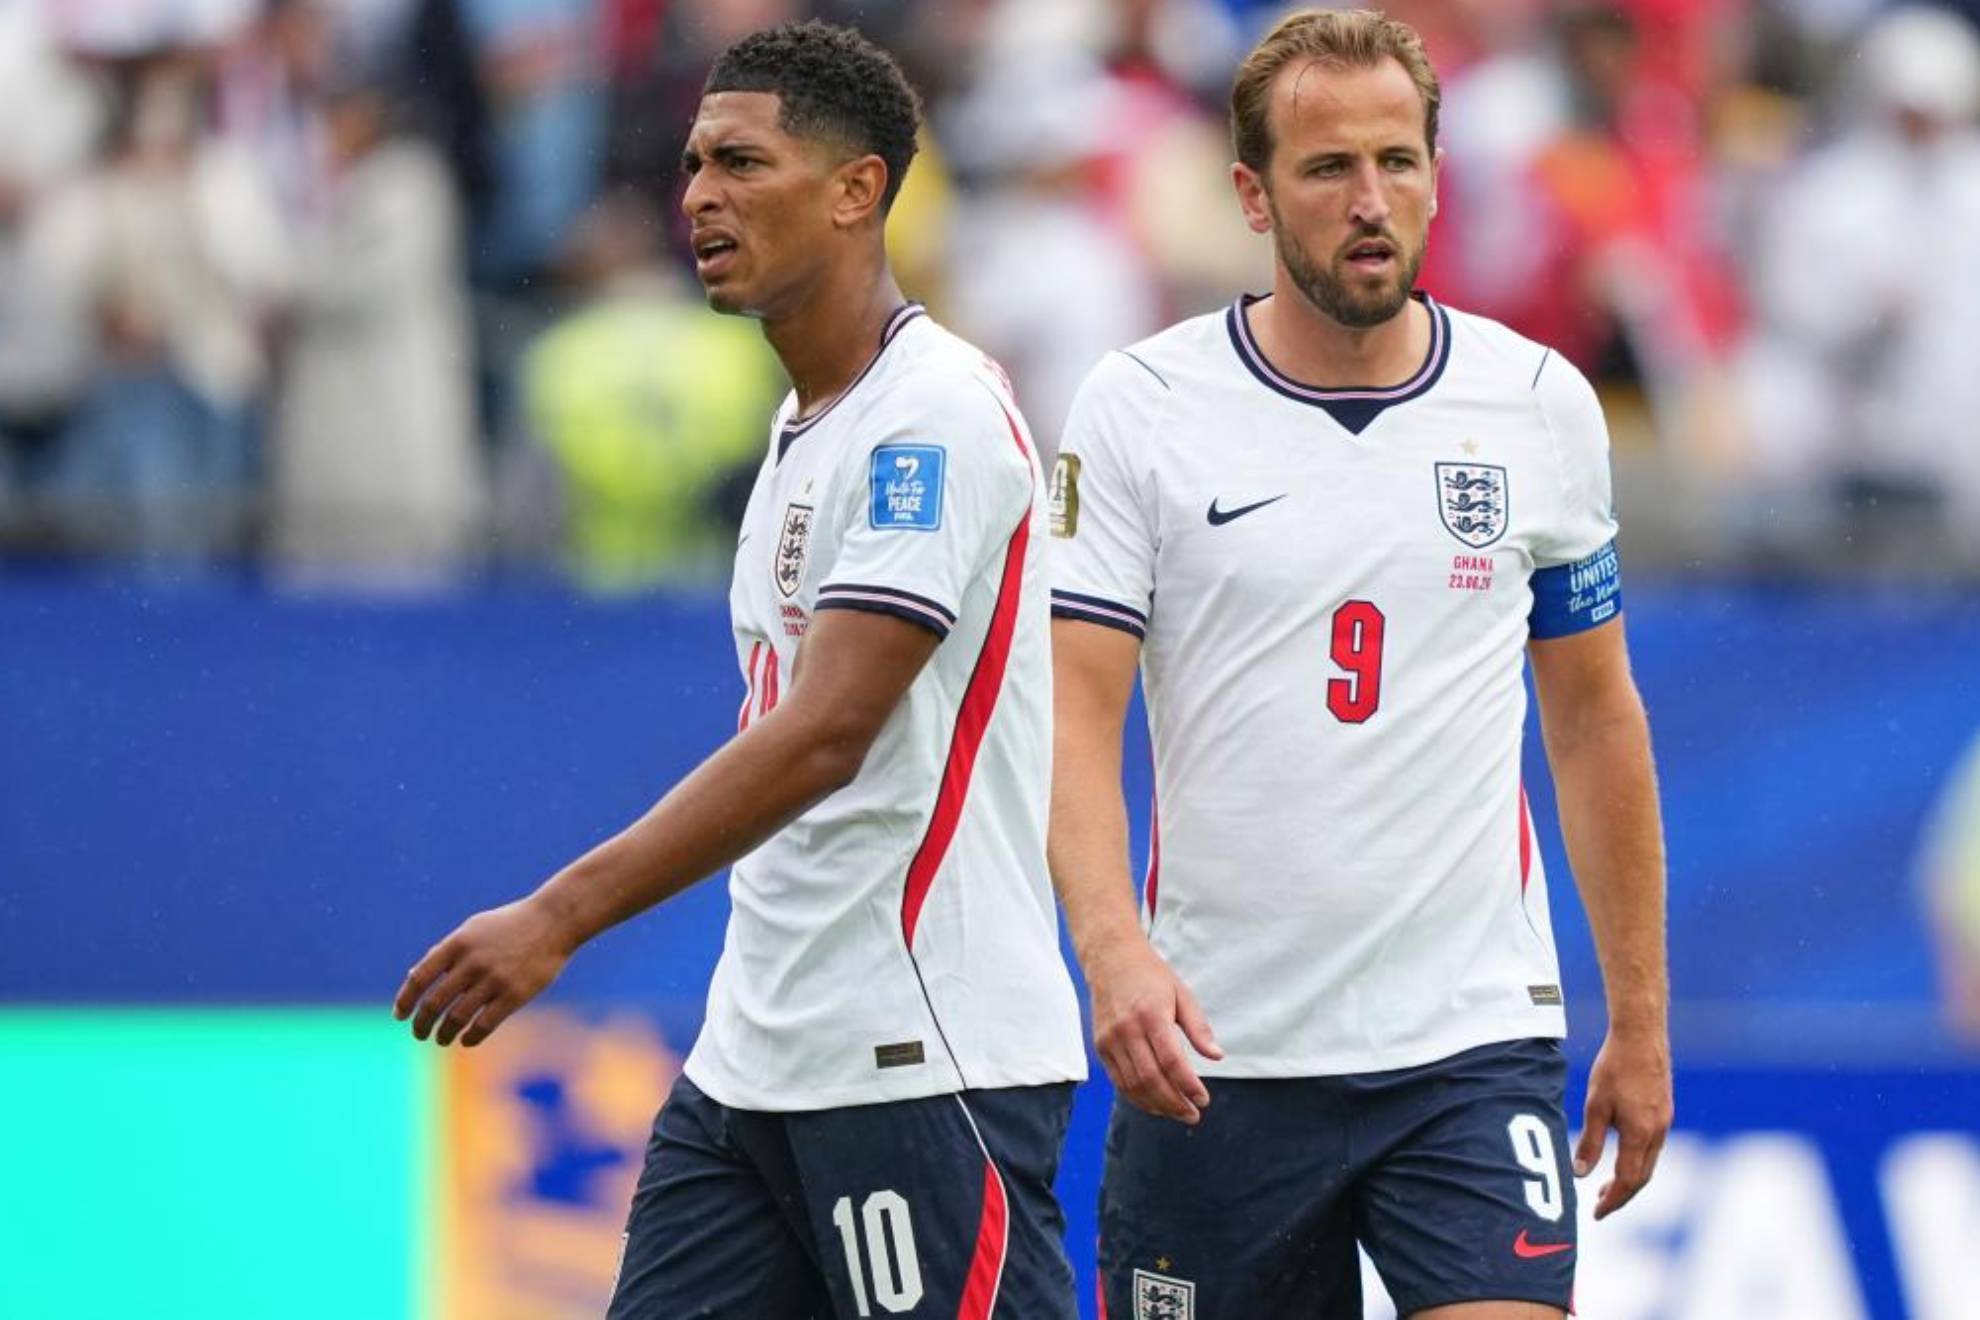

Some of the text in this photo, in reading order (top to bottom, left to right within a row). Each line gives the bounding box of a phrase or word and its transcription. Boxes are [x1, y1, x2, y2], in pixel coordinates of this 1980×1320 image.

[888, 496, 922, 512] PEACE
[1570, 552, 1618, 593] UNITES
[1326, 599, 1385, 724] 9
[1507, 1113, 1563, 1223] 9
[833, 1189, 924, 1317] 10
